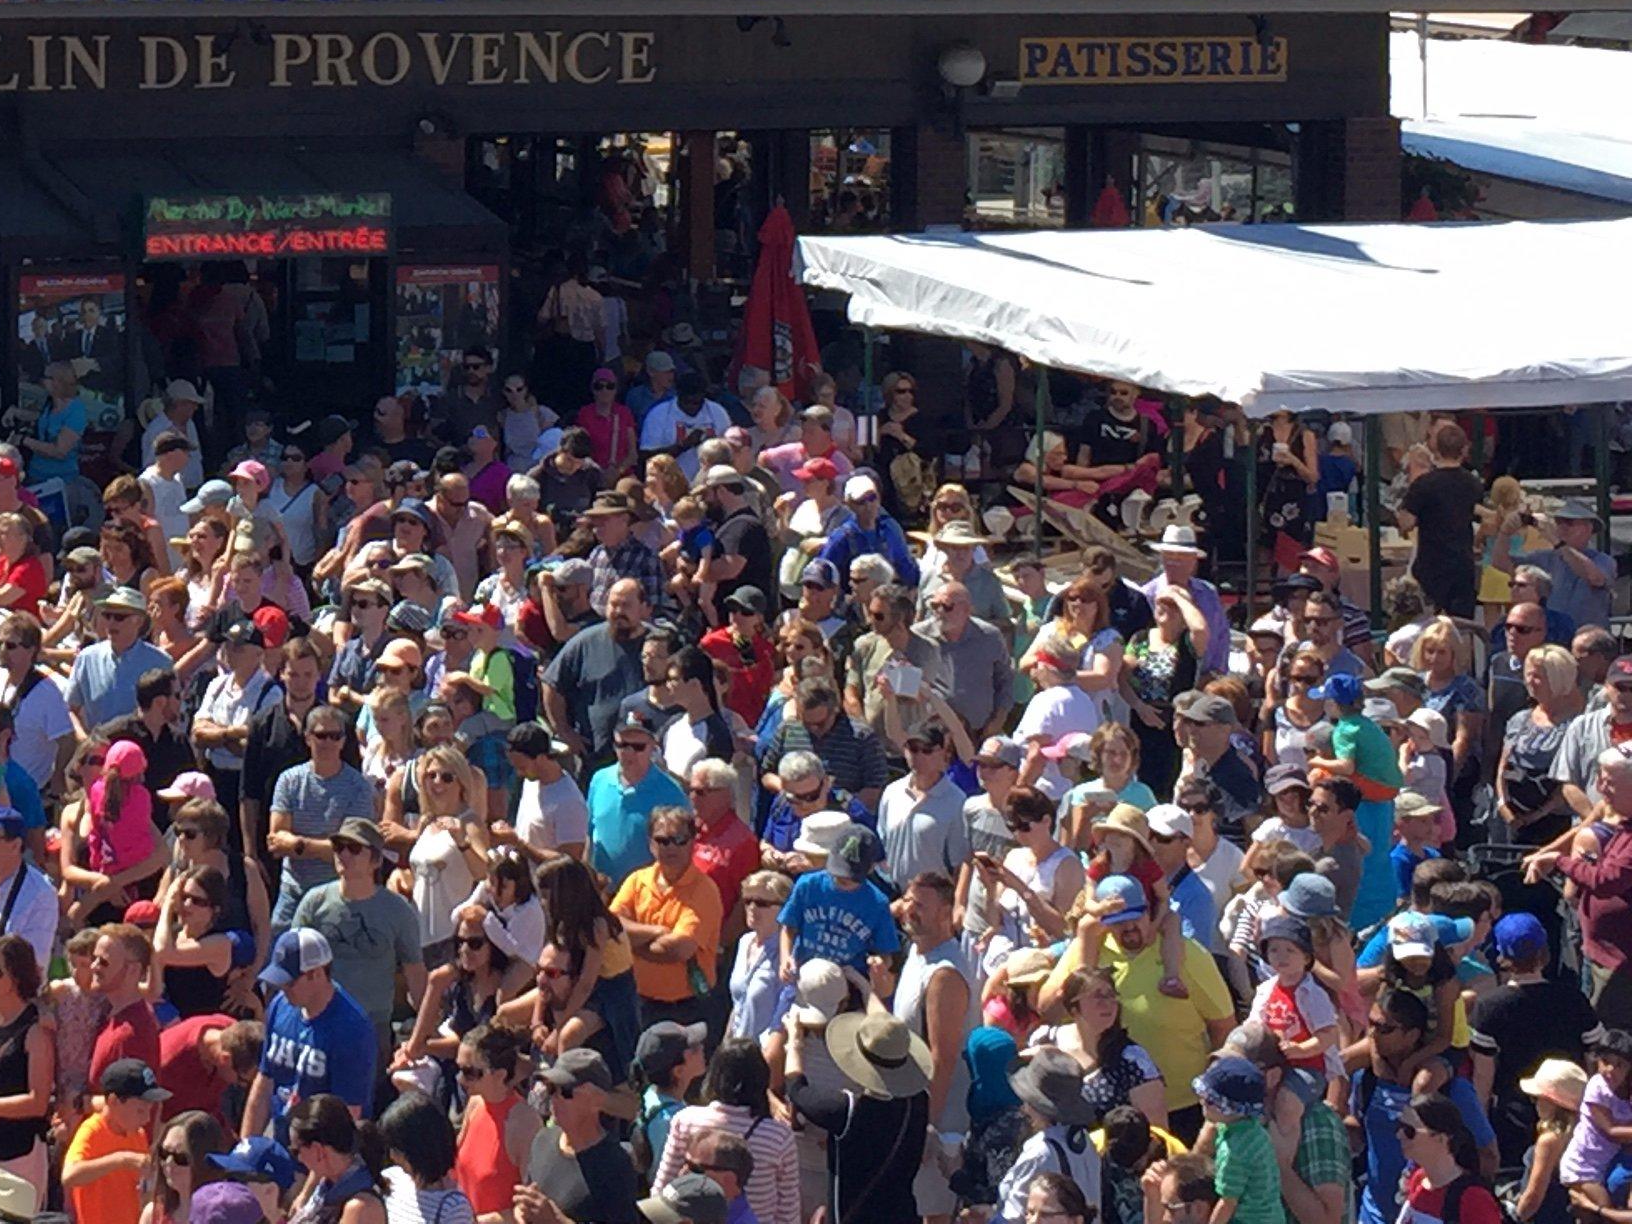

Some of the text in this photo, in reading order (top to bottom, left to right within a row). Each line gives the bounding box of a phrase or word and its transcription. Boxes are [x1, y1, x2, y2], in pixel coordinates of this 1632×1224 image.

[138, 34, 237, 90] DE
[268, 31, 657, 87] PROVENCE
[1024, 40, 1283, 77] PATISSERIE
